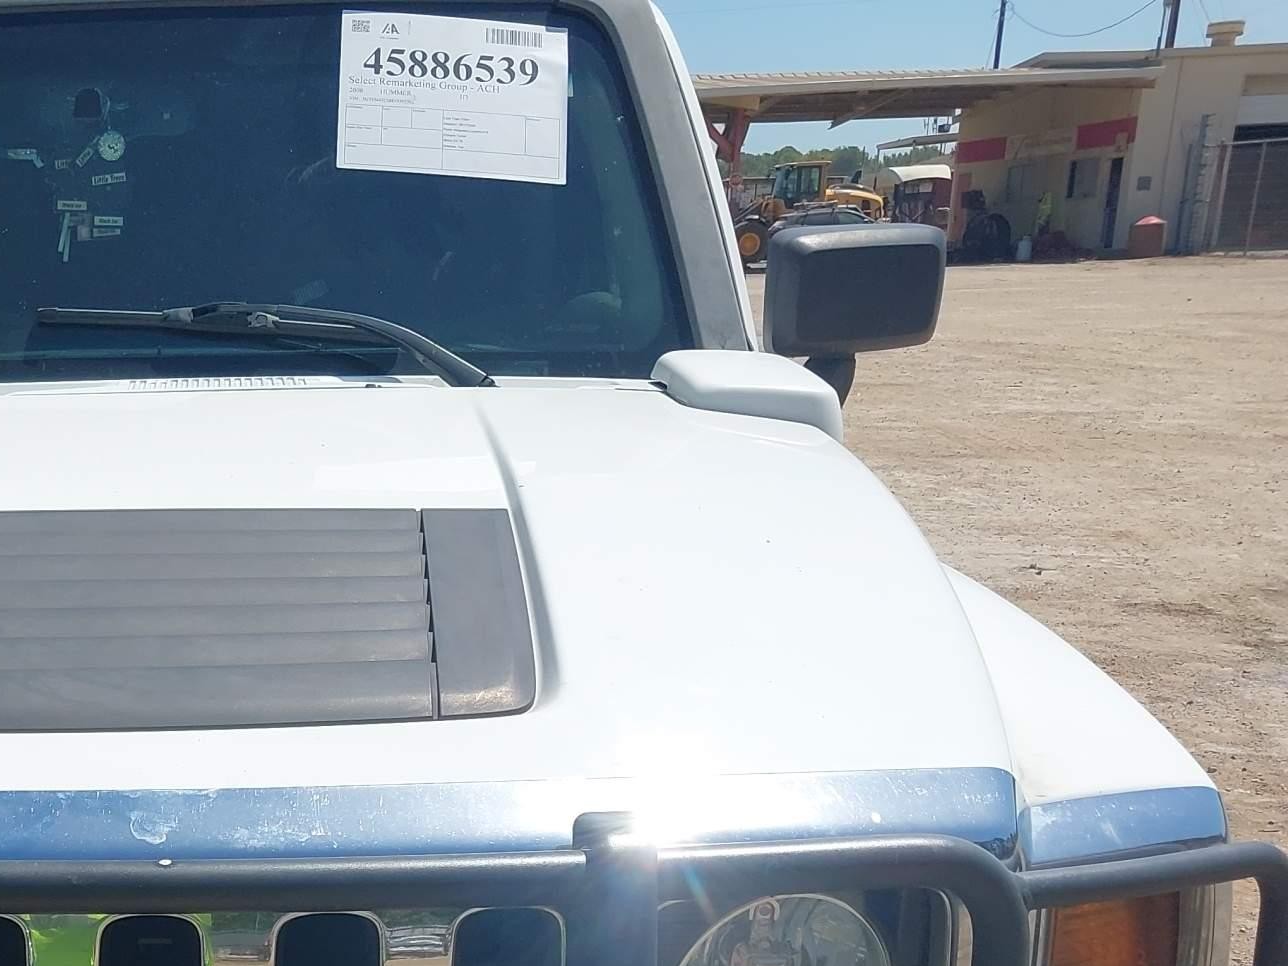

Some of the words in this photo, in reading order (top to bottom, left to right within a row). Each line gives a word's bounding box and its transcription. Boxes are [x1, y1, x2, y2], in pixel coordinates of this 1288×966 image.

[363, 47, 539, 86] 45886539
[348, 75, 376, 86] Select
[379, 77, 436, 90] Remarketing
[439, 81, 468, 92] Group
